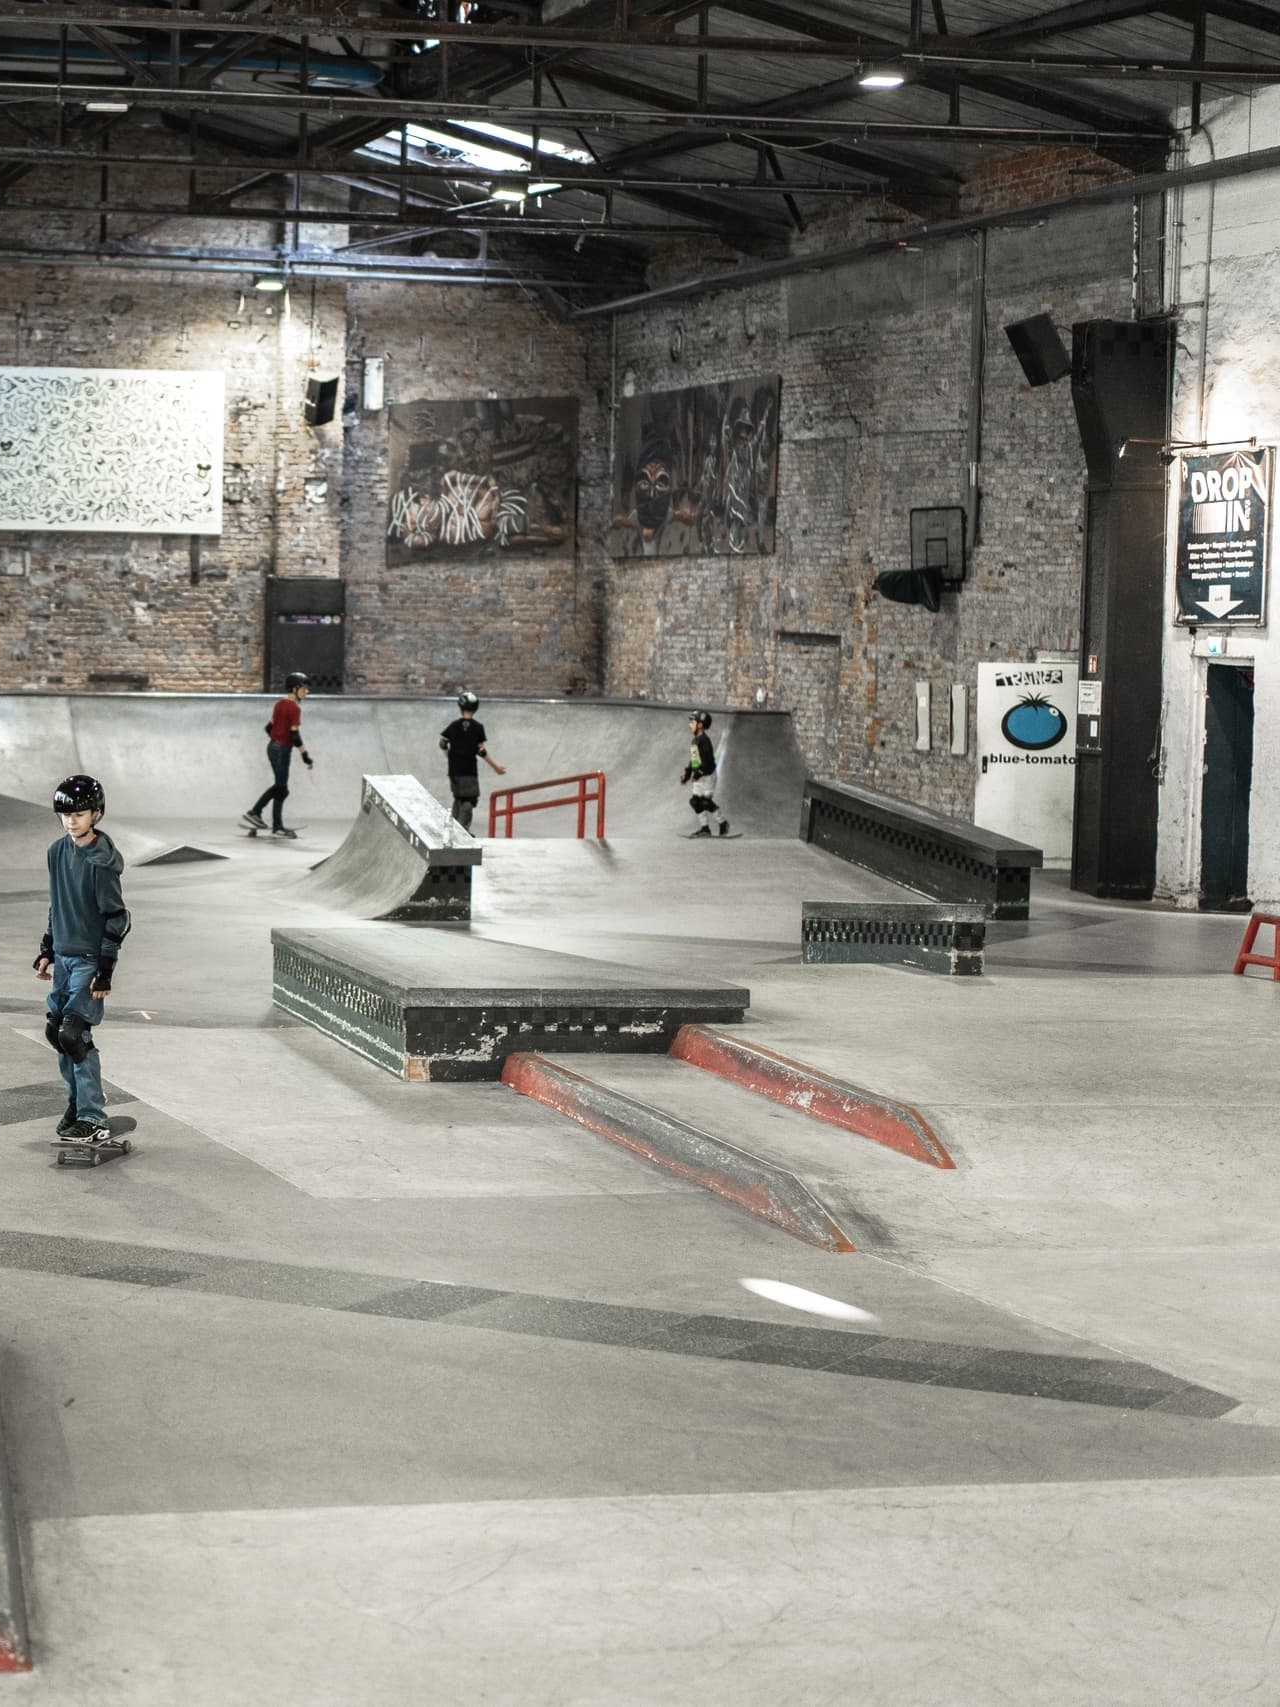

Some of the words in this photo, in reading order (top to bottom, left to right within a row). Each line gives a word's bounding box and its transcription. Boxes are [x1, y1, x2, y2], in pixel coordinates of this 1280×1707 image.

[1191, 466, 1253, 503] DROP
[1226, 500, 1251, 532] IN
[989, 753, 1077, 765] blue-tomato
